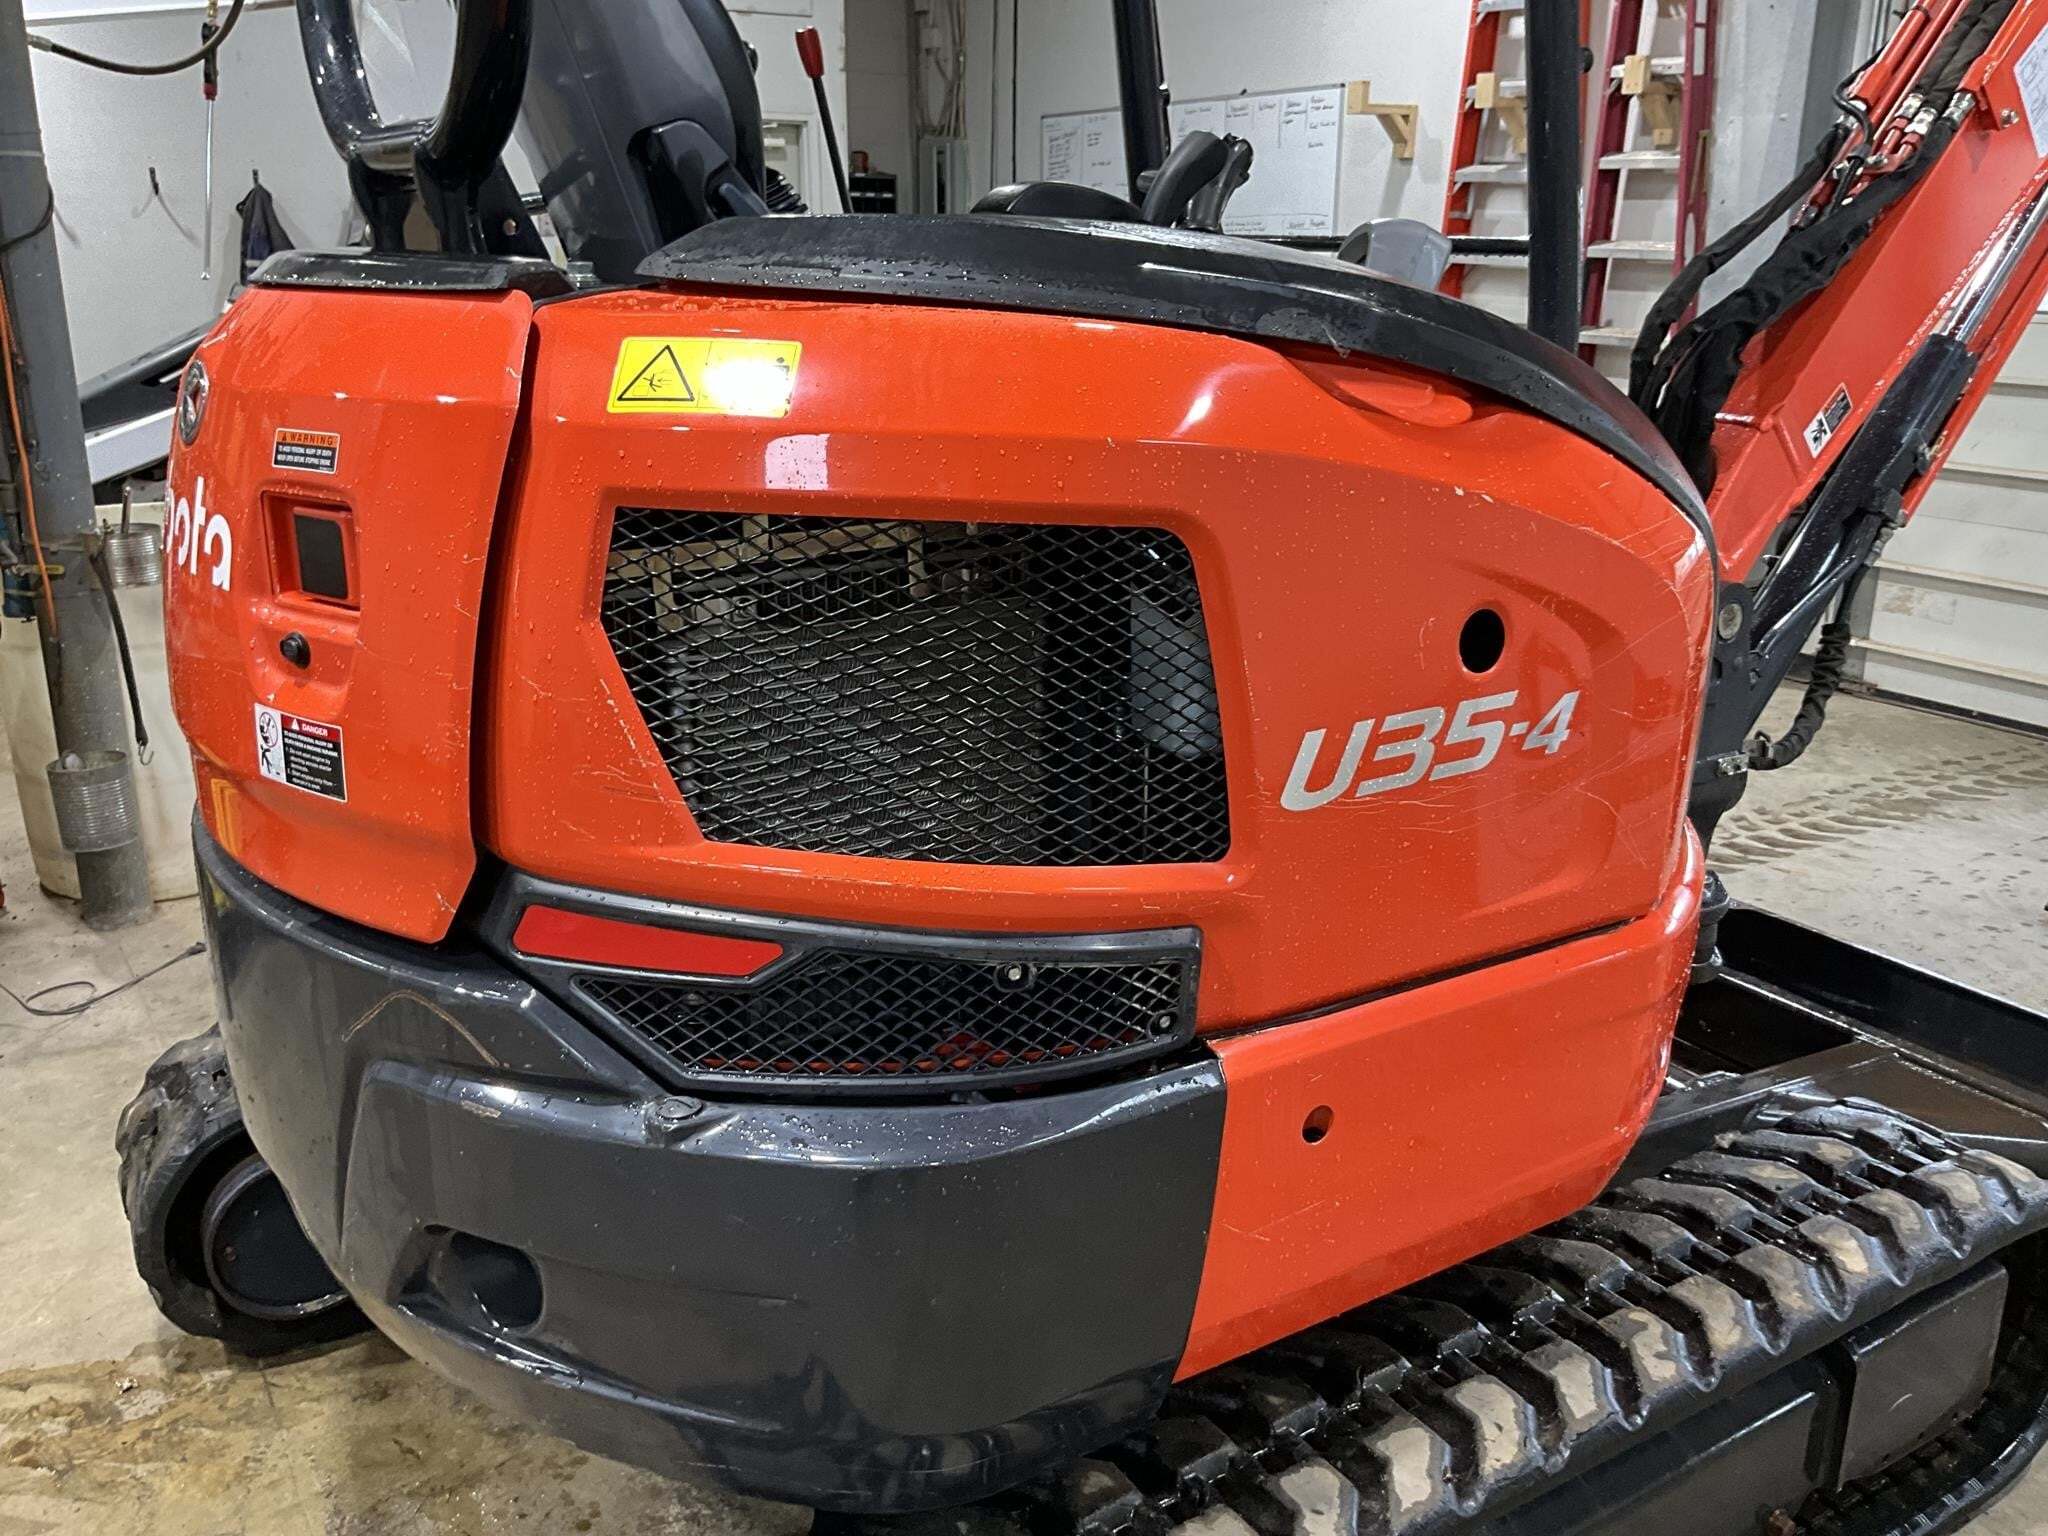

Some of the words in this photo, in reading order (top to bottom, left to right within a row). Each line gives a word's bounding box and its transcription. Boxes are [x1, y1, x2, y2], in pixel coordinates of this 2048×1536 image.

[290, 432, 333, 446] WARNING
[302, 723, 328, 737] DANGER
[1280, 690, 1580, 811] U35-4
